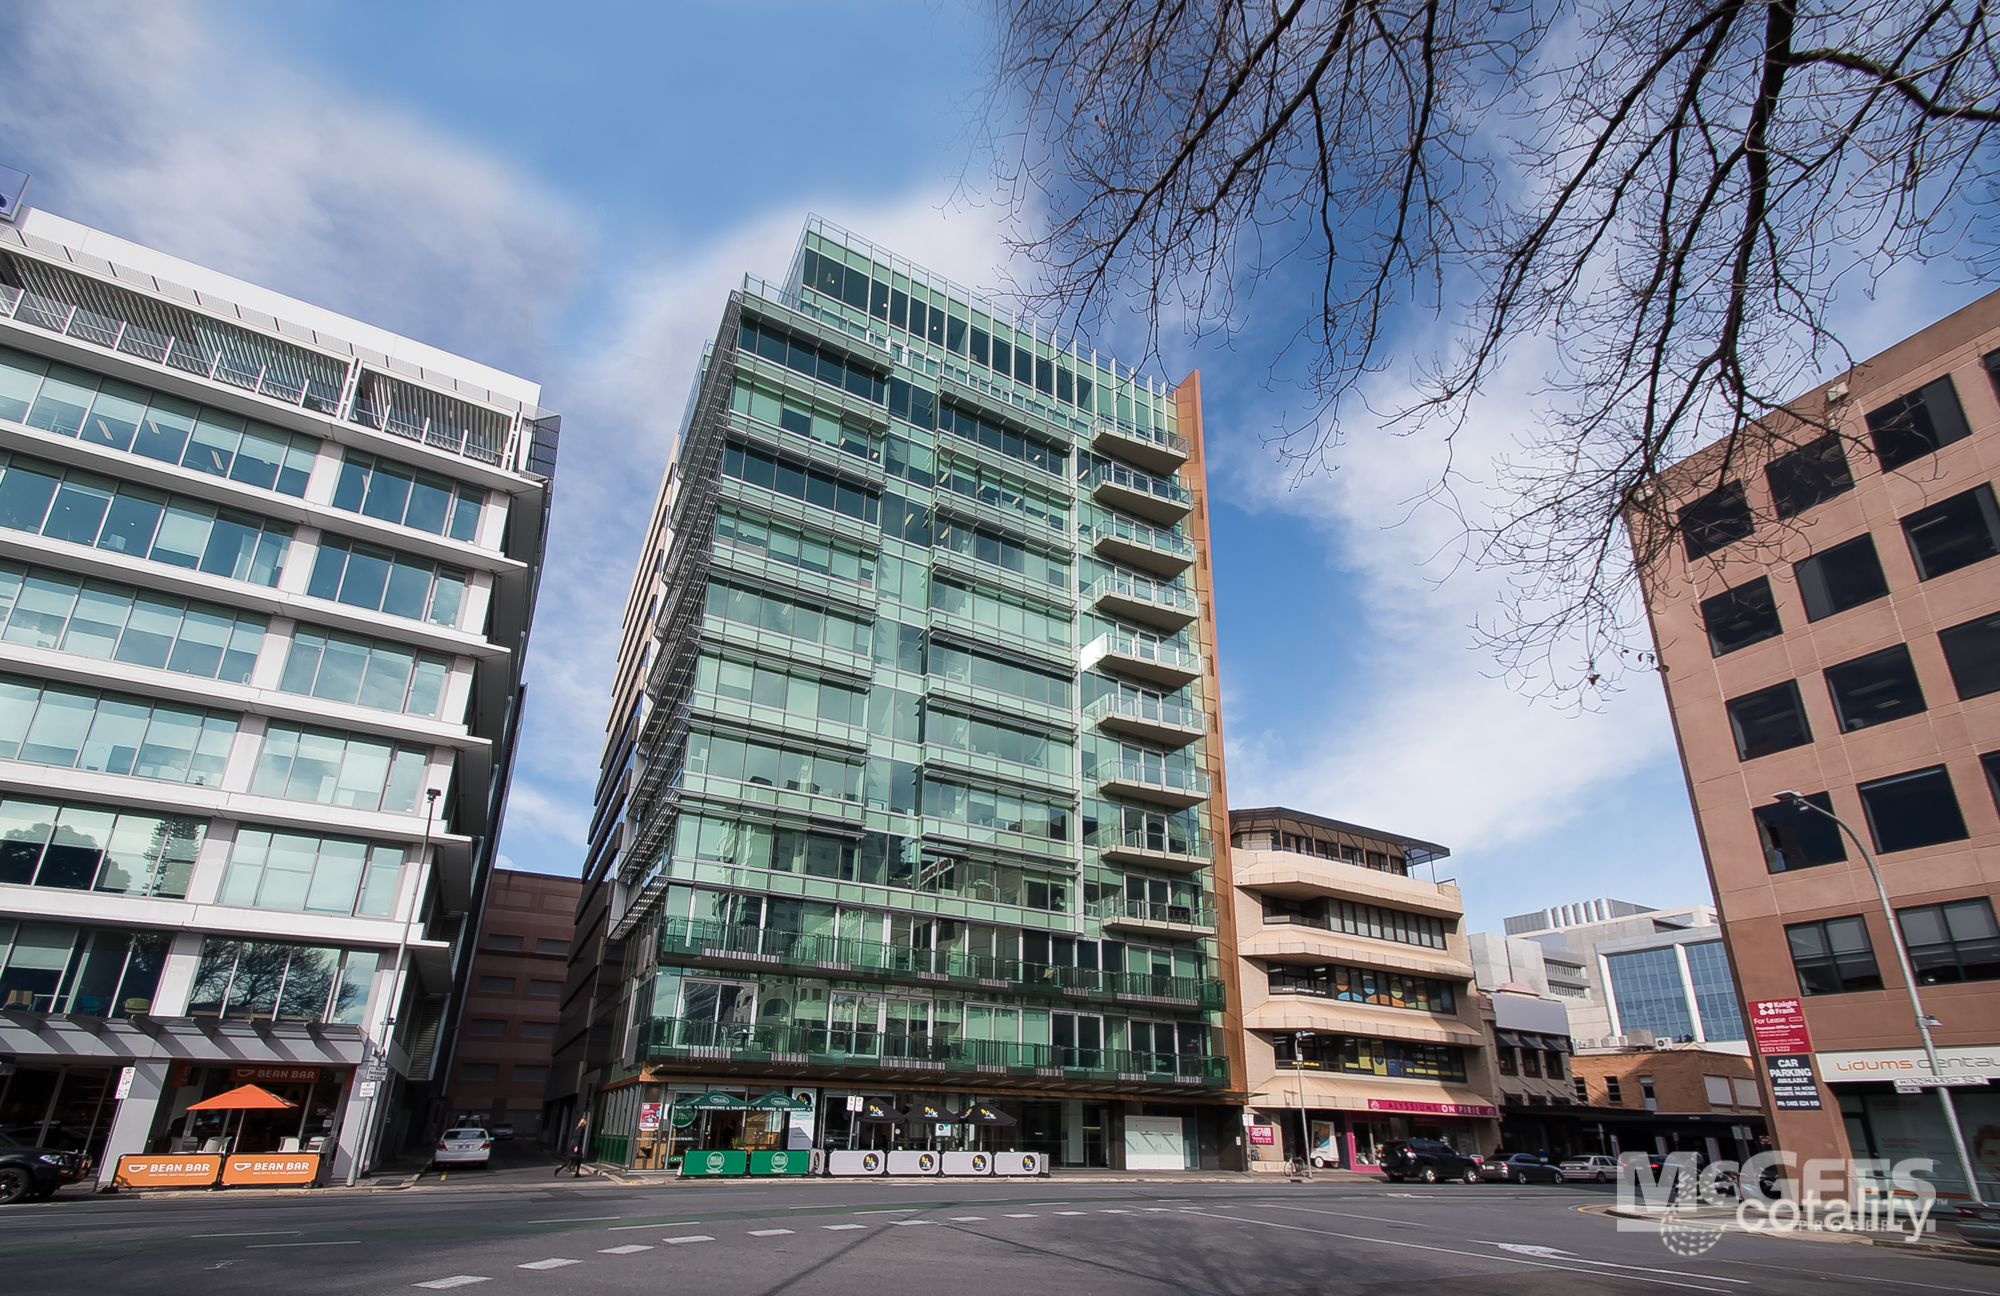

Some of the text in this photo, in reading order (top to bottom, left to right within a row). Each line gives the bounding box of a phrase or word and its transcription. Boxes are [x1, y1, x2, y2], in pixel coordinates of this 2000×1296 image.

[1774, 1001, 1799, 1009] Knight
[1777, 1059, 1799, 1067] CAR
[1836, 1059, 1914, 1072] Lidums
[257, 1069, 316, 1080] BEAN BAR
[1769, 1068, 1812, 1077] PARKING
[1441, 1105, 1455, 1113] ON
[1459, 1105, 1481, 1115] PIRIE
[149, 1162, 210, 1173] BEAN BAR
[253, 1161, 310, 1171] BEAN BAR
